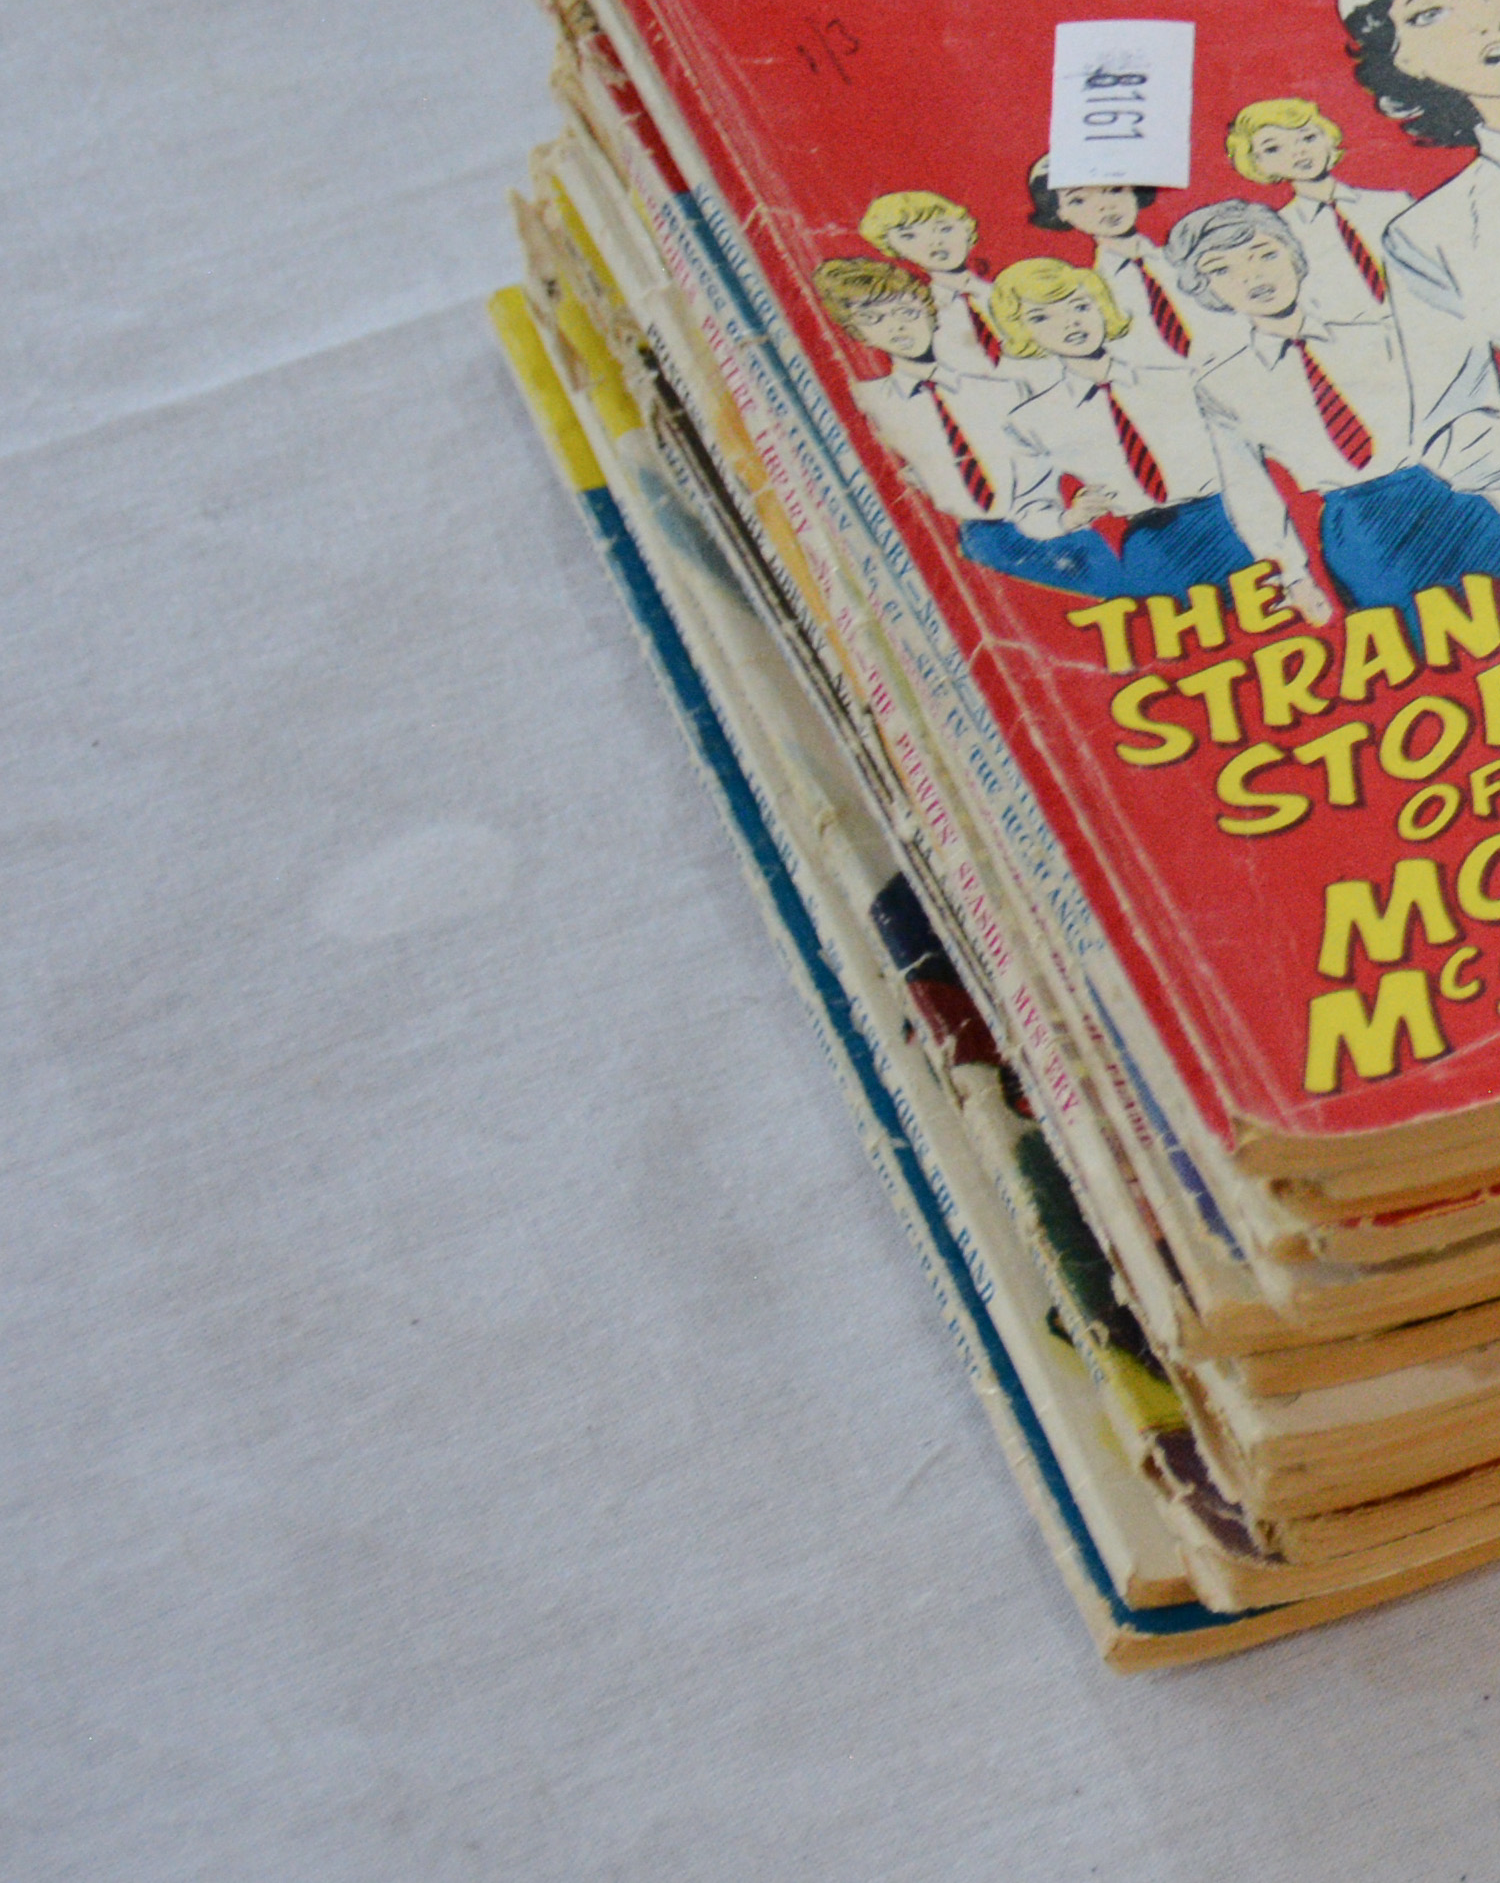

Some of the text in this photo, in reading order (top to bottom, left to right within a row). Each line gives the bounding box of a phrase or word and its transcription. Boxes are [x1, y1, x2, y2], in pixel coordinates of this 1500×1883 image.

[1065, 559, 1296, 674] THE
[941, 858, 1025, 977] SEASIDE
[946, 1223, 1002, 1308] BAND
